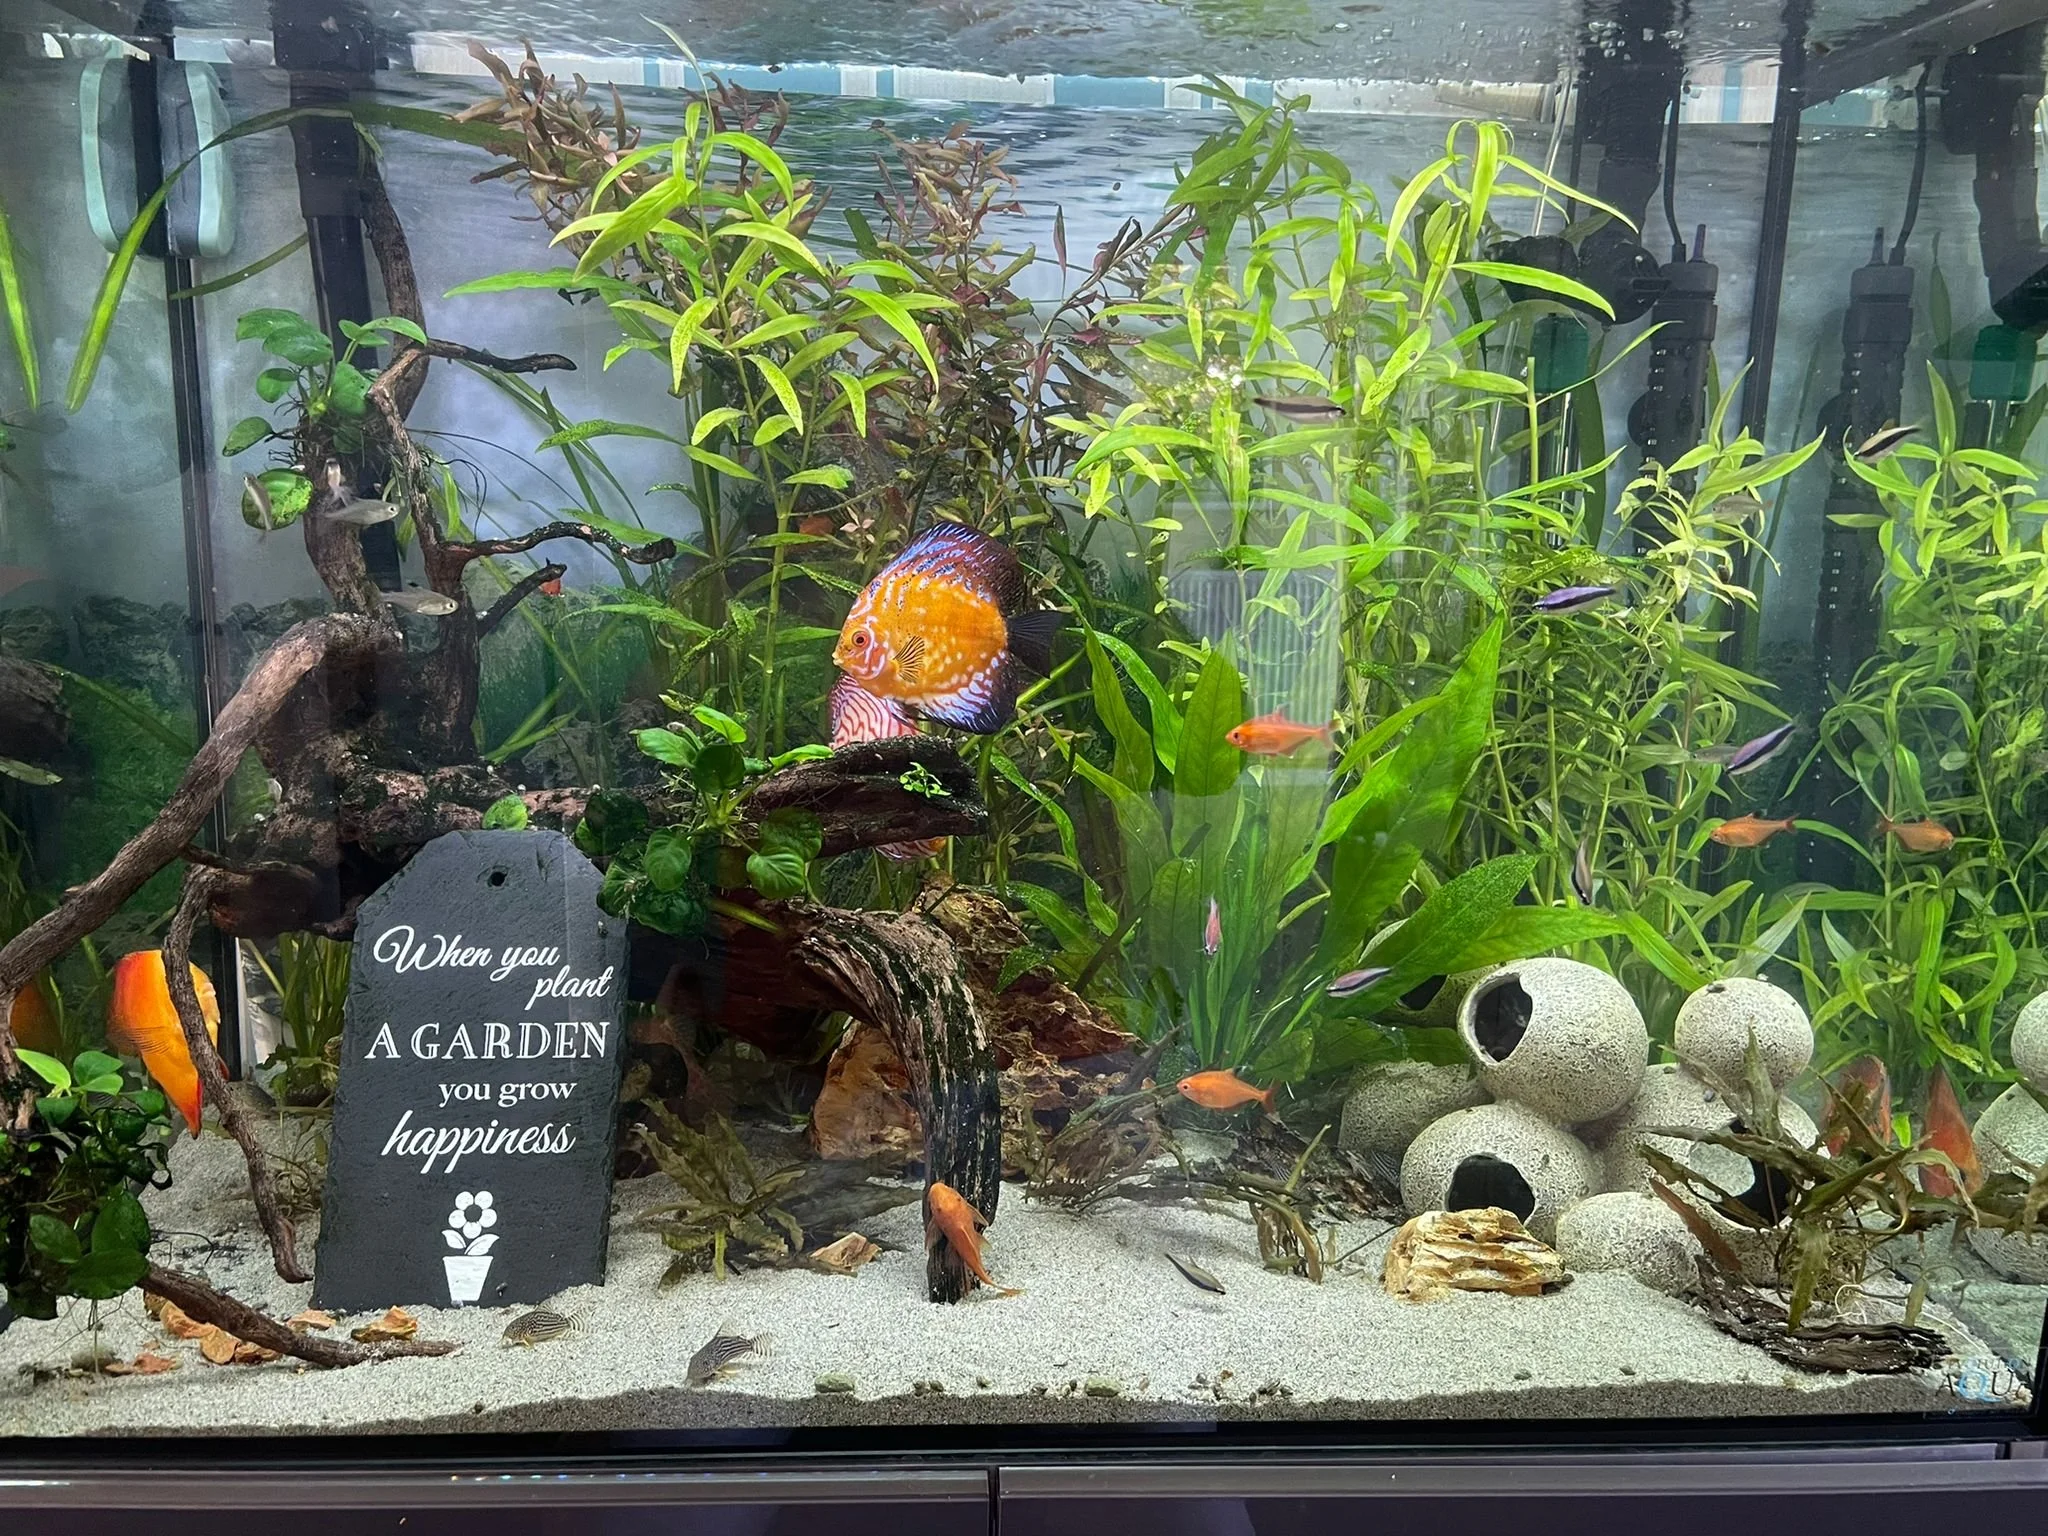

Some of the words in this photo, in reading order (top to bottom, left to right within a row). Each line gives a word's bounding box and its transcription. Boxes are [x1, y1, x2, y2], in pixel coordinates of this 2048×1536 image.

[373, 924, 492, 974] When
[490, 946, 560, 982] you
[525, 964, 614, 1011] plant
[364, 1022, 402, 1060] A
[410, 1021, 611, 1060] GARDEN
[438, 1083, 491, 1108] you
[497, 1082, 578, 1108] grow
[380, 1109, 577, 1175] happiness
